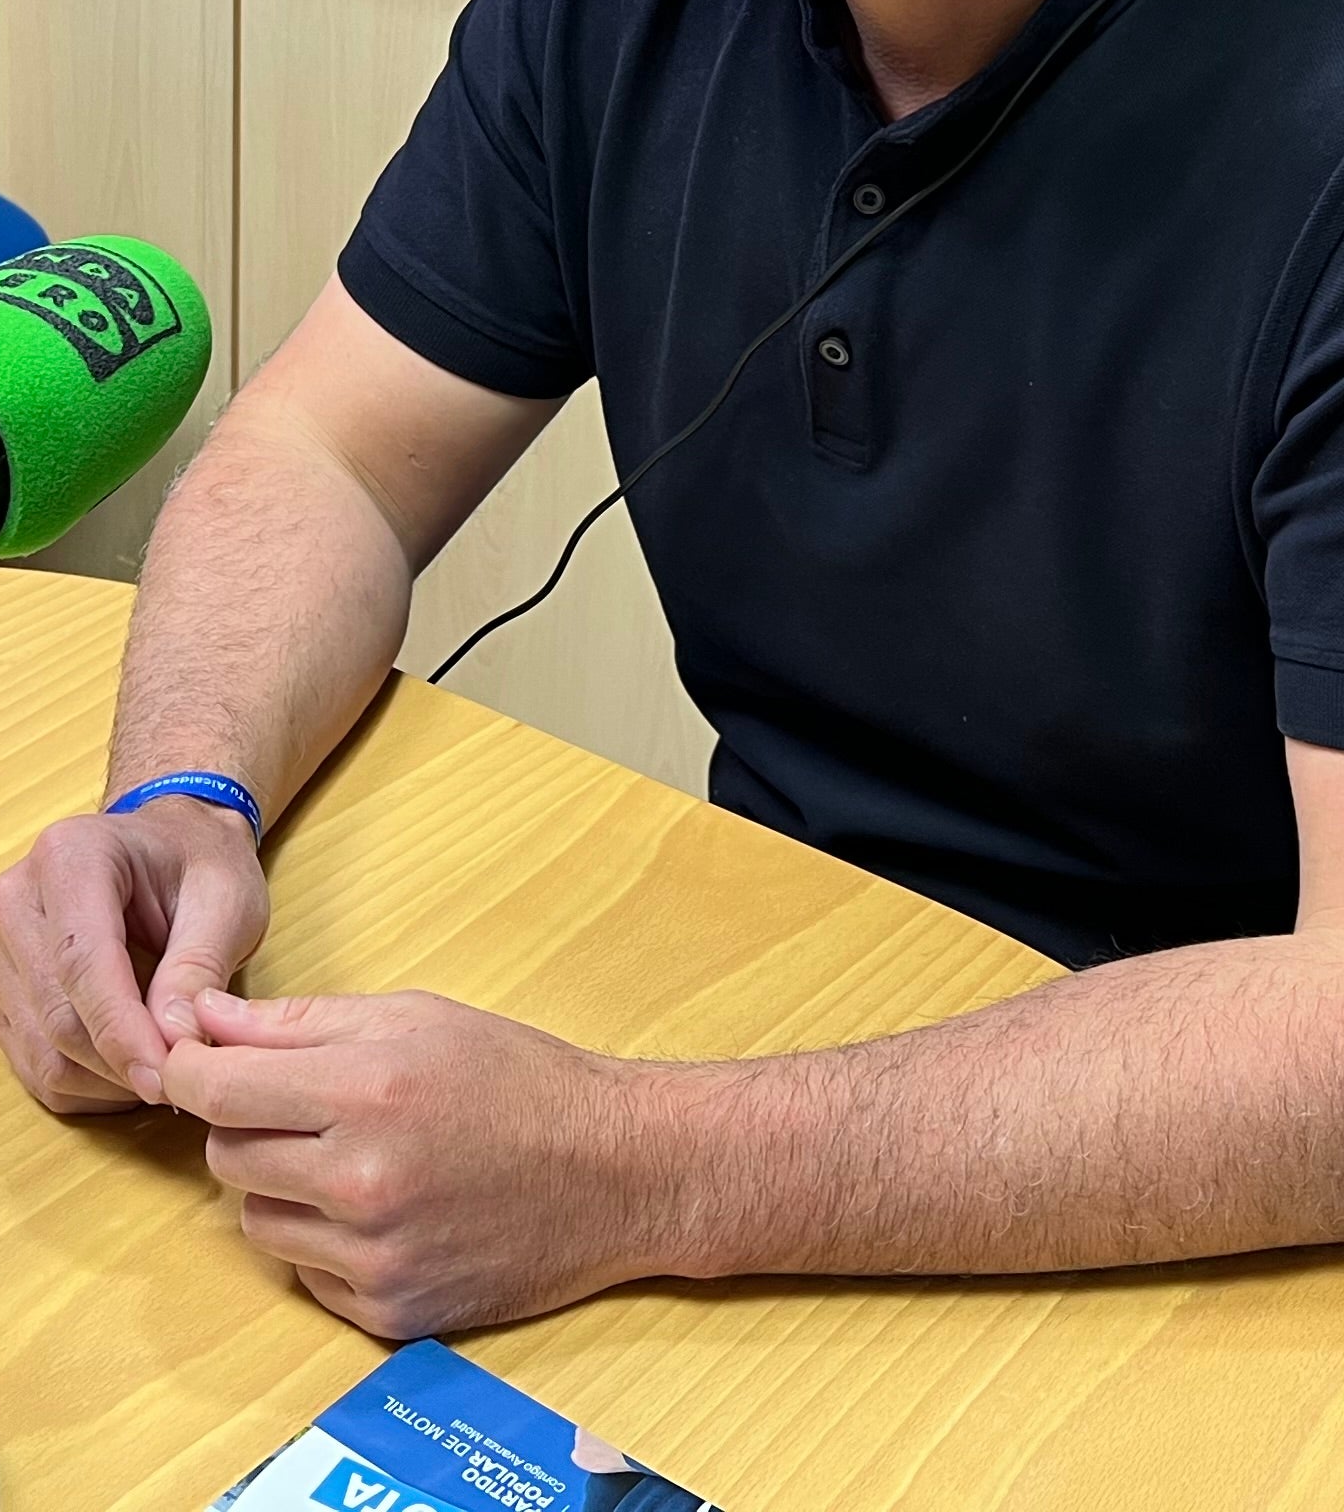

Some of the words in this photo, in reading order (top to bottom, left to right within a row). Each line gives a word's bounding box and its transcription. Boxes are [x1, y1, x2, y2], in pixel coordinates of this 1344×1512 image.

[383, 1395, 445, 1441] MOTRIL
[450, 1418, 484, 1443] Motril
[441, 1436, 472, 1458] DE
[482, 1437, 528, 1466] Avanza
[469, 1450, 554, 1509] POPULAR
[524, 1461, 566, 1494] Contigo
